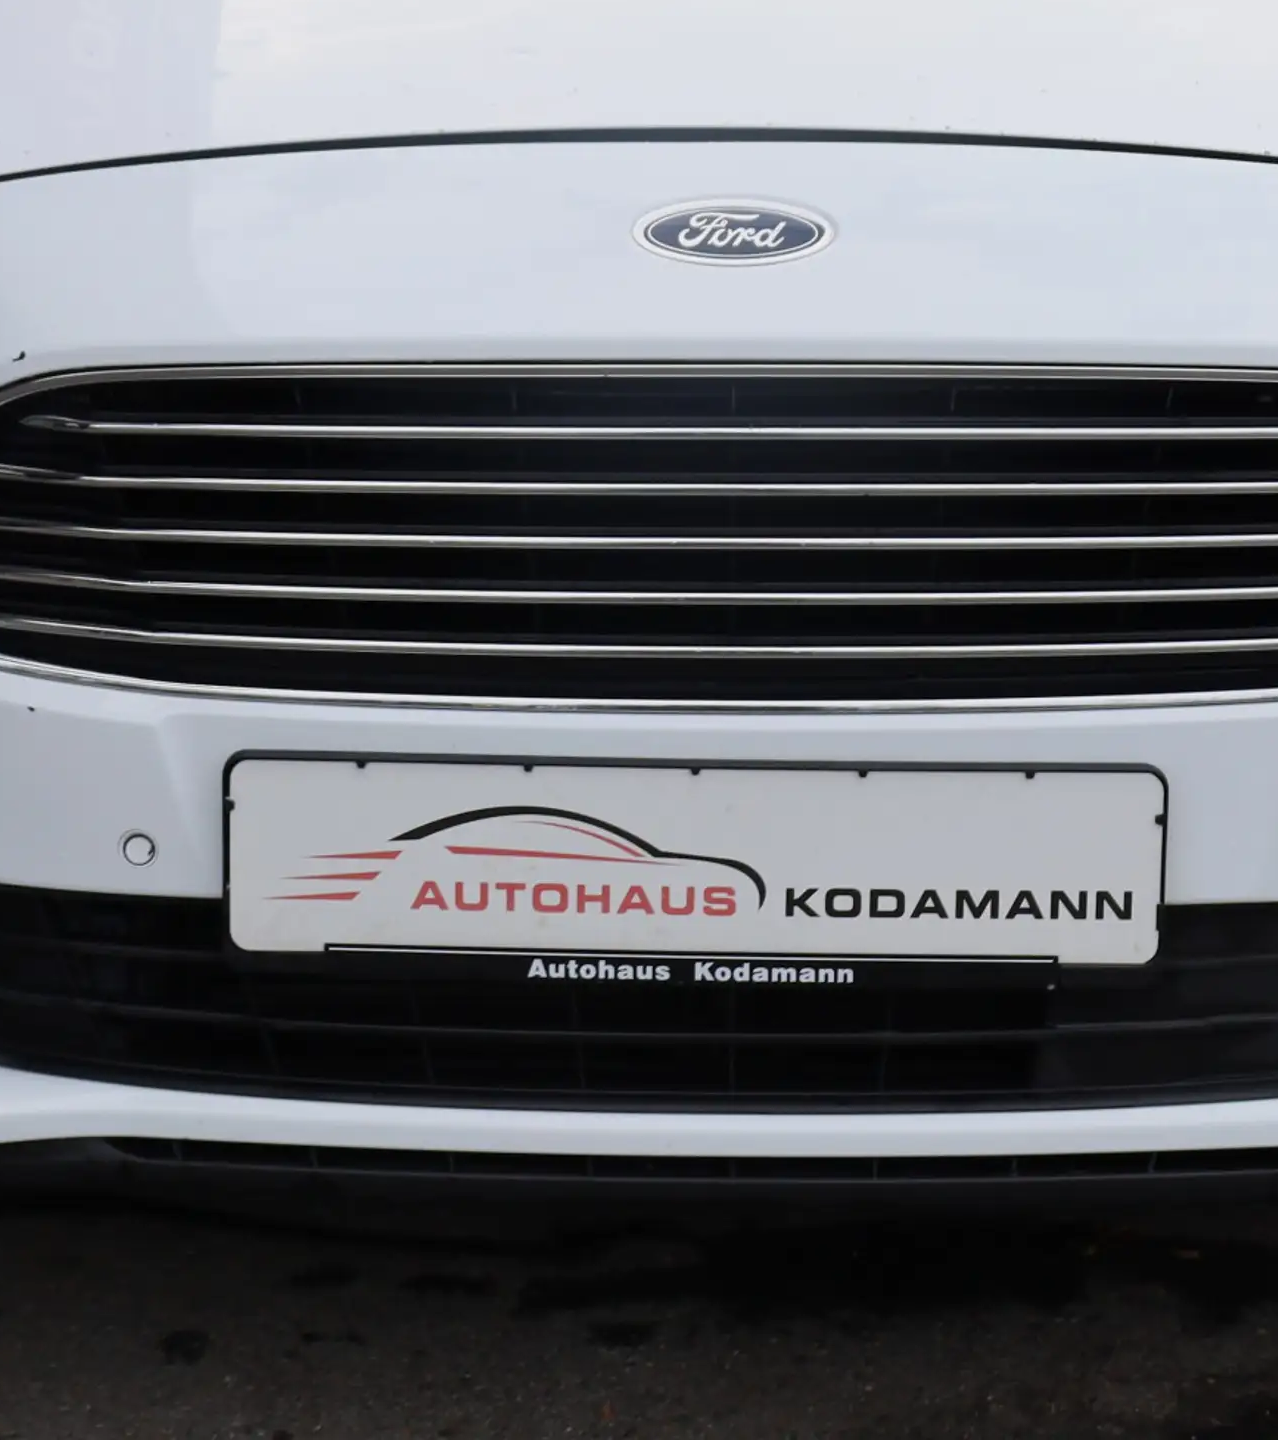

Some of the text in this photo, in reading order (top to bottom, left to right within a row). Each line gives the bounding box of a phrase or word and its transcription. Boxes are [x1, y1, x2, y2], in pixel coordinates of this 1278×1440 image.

[677, 210, 787, 250] Ford
[411, 880, 1134, 922] AUTOHAUS KODAMANN
[526, 957, 856, 985] Autohaus Kodamann
